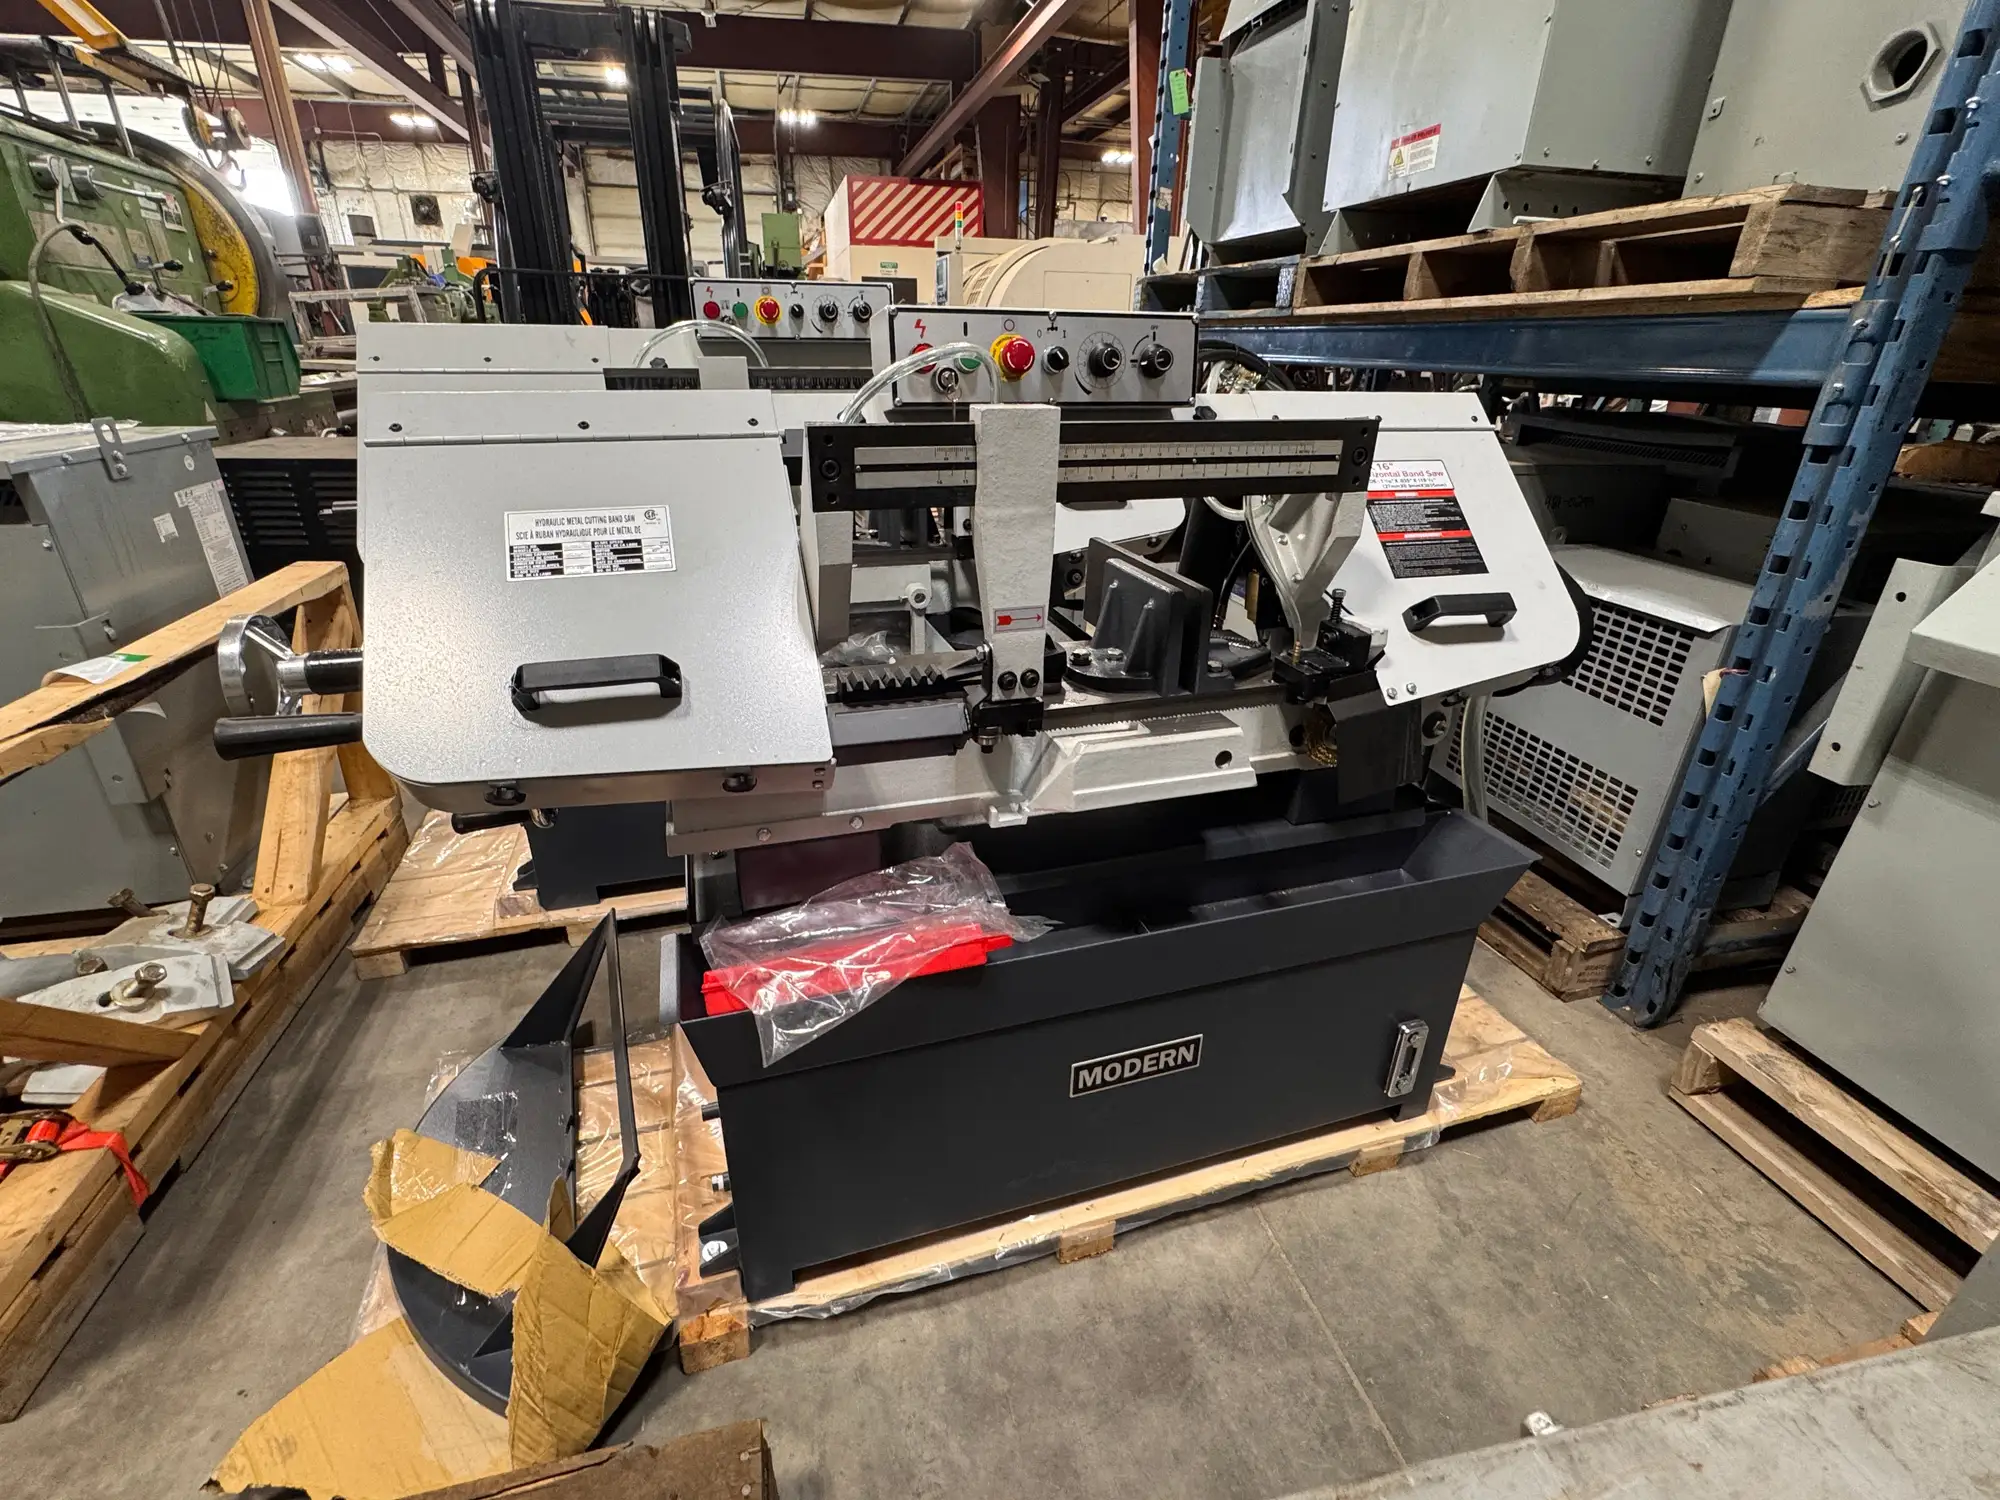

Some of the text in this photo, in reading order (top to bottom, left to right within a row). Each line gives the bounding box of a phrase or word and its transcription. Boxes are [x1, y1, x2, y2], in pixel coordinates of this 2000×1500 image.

[534, 516, 565, 527] HYDRAULIC
[566, 515, 584, 525] METAL
[584, 514, 608, 525] CUTTING
[608, 514, 623, 524] BAND
[624, 514, 636, 523] SAW
[515, 525, 641, 540] SCIE À RUBAN HYDRAULIQUE POUR LE MÉTAL DE
[1078, 1044, 1195, 1089] MODERN
